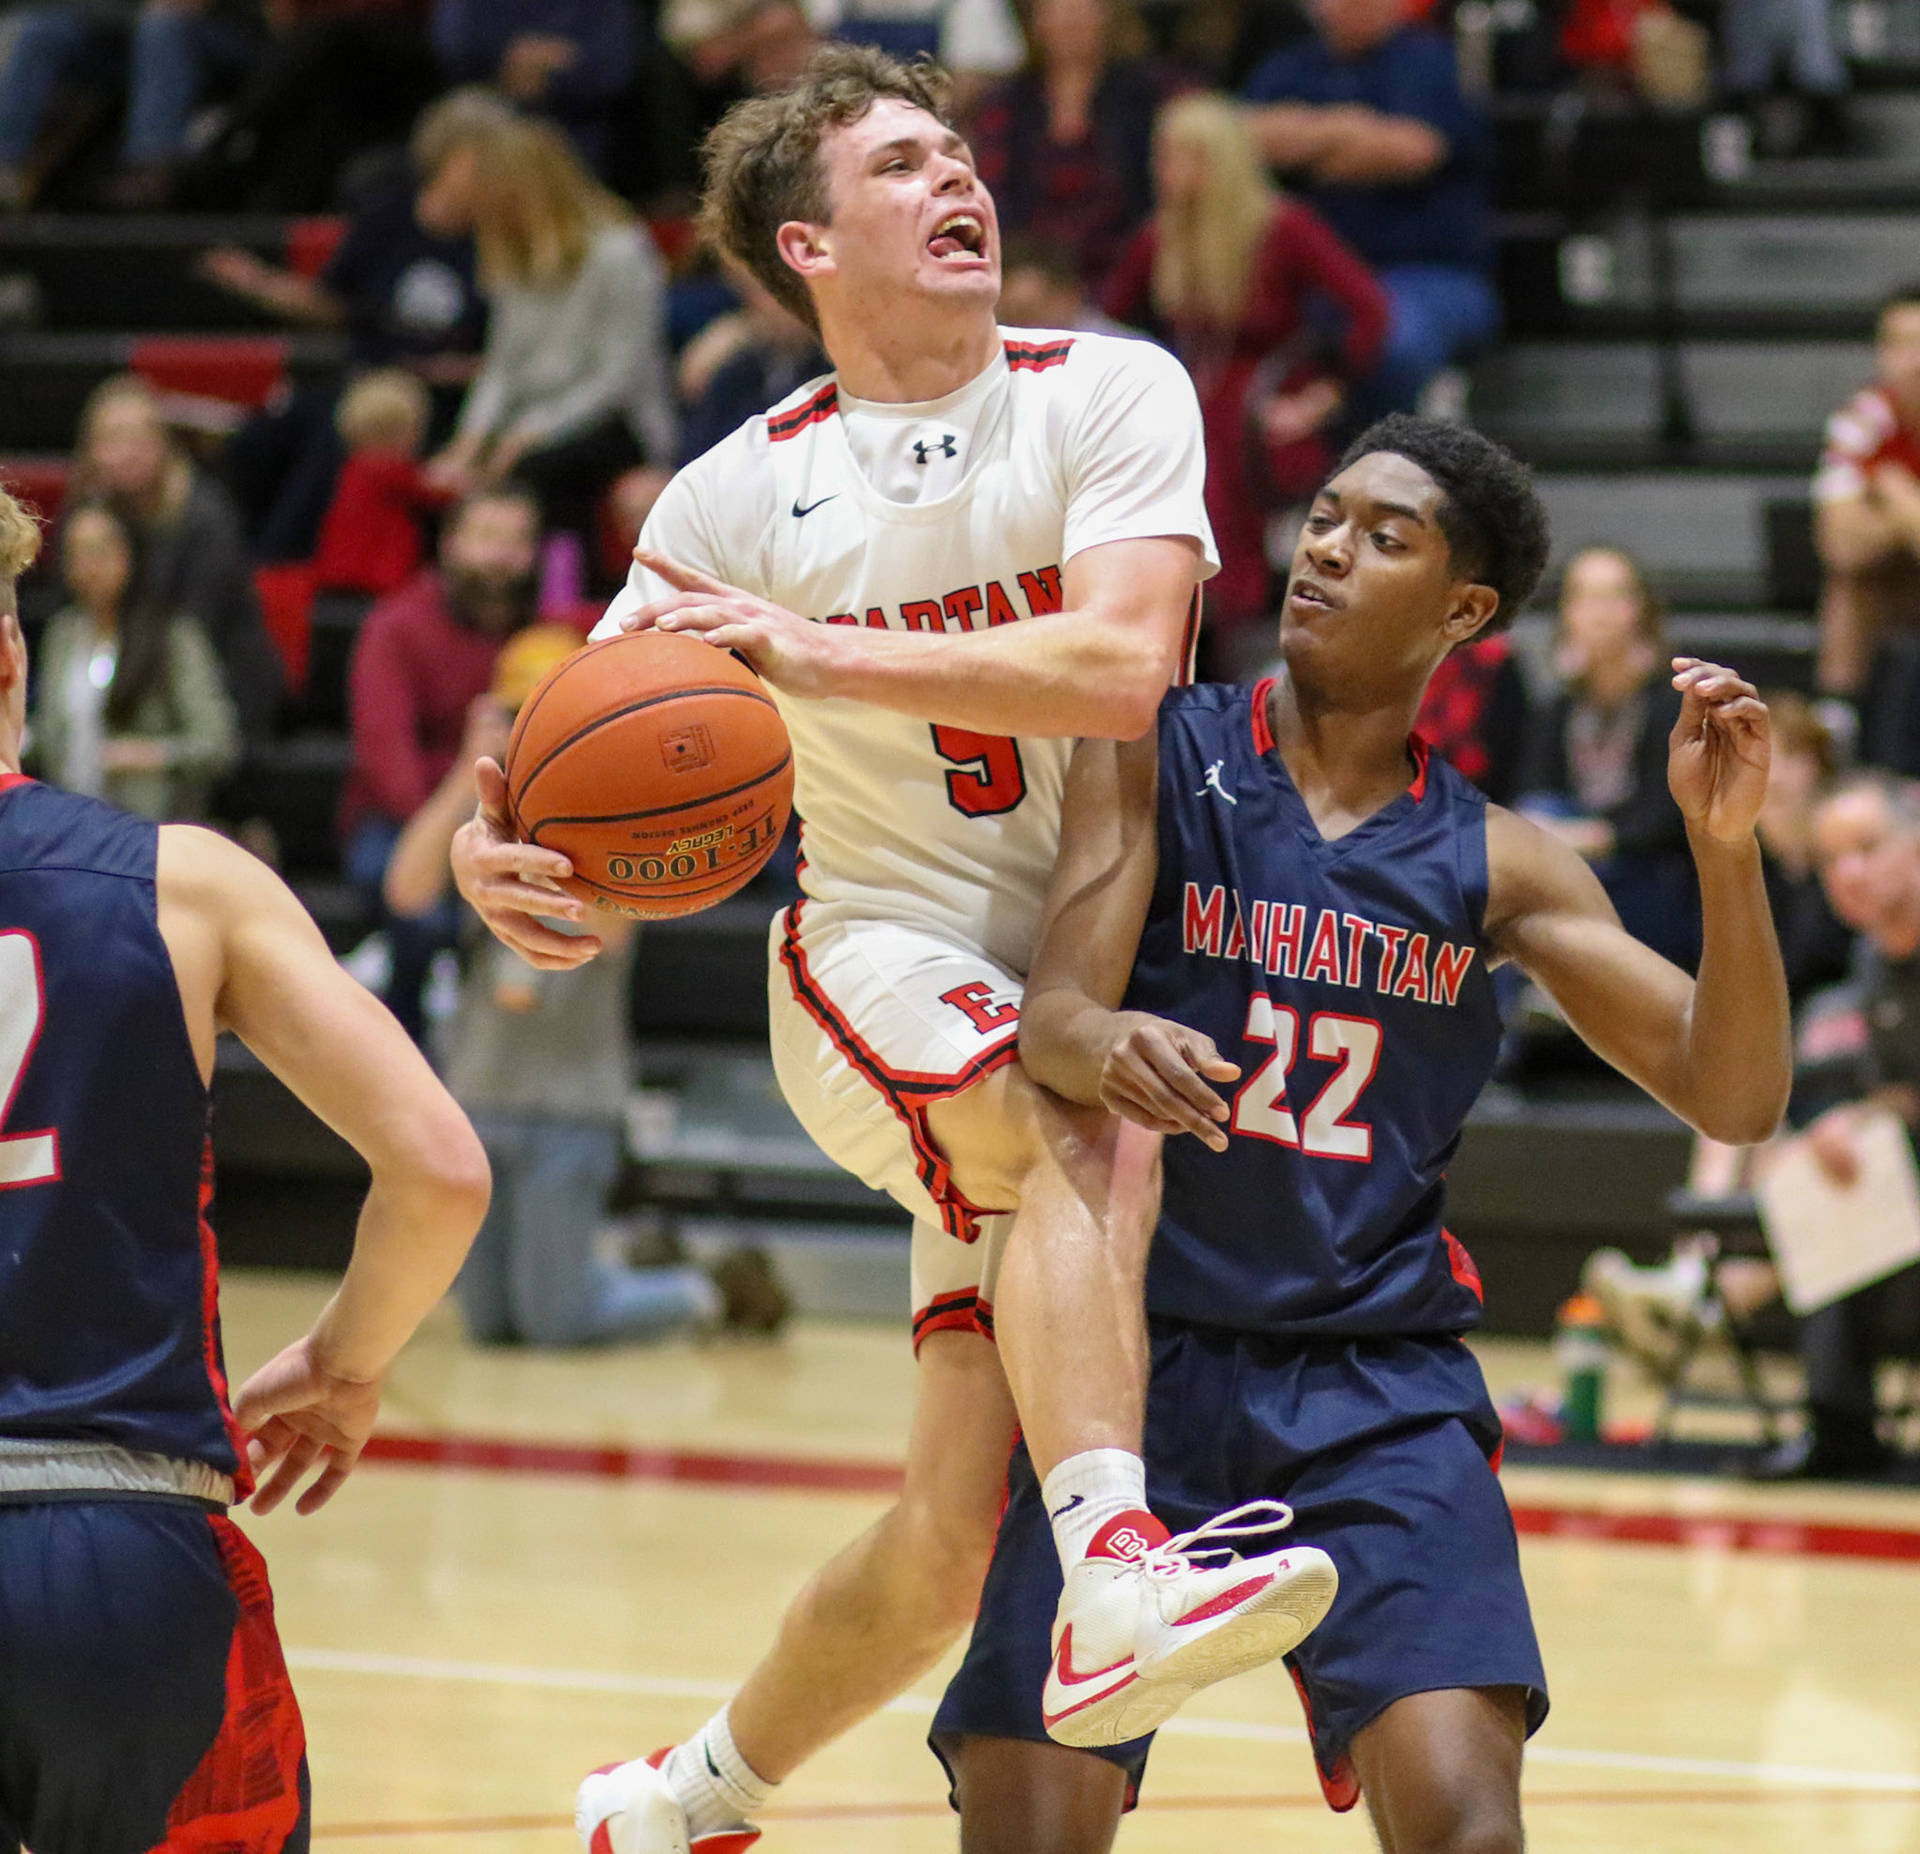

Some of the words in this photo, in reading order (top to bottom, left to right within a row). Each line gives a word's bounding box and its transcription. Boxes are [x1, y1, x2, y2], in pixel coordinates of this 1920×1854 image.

[631, 828, 676, 840] DESIGN
[665, 822, 735, 856] LEGACY
[938, 980, 1020, 1035] E
[1230, 990, 1384, 1163] 22
